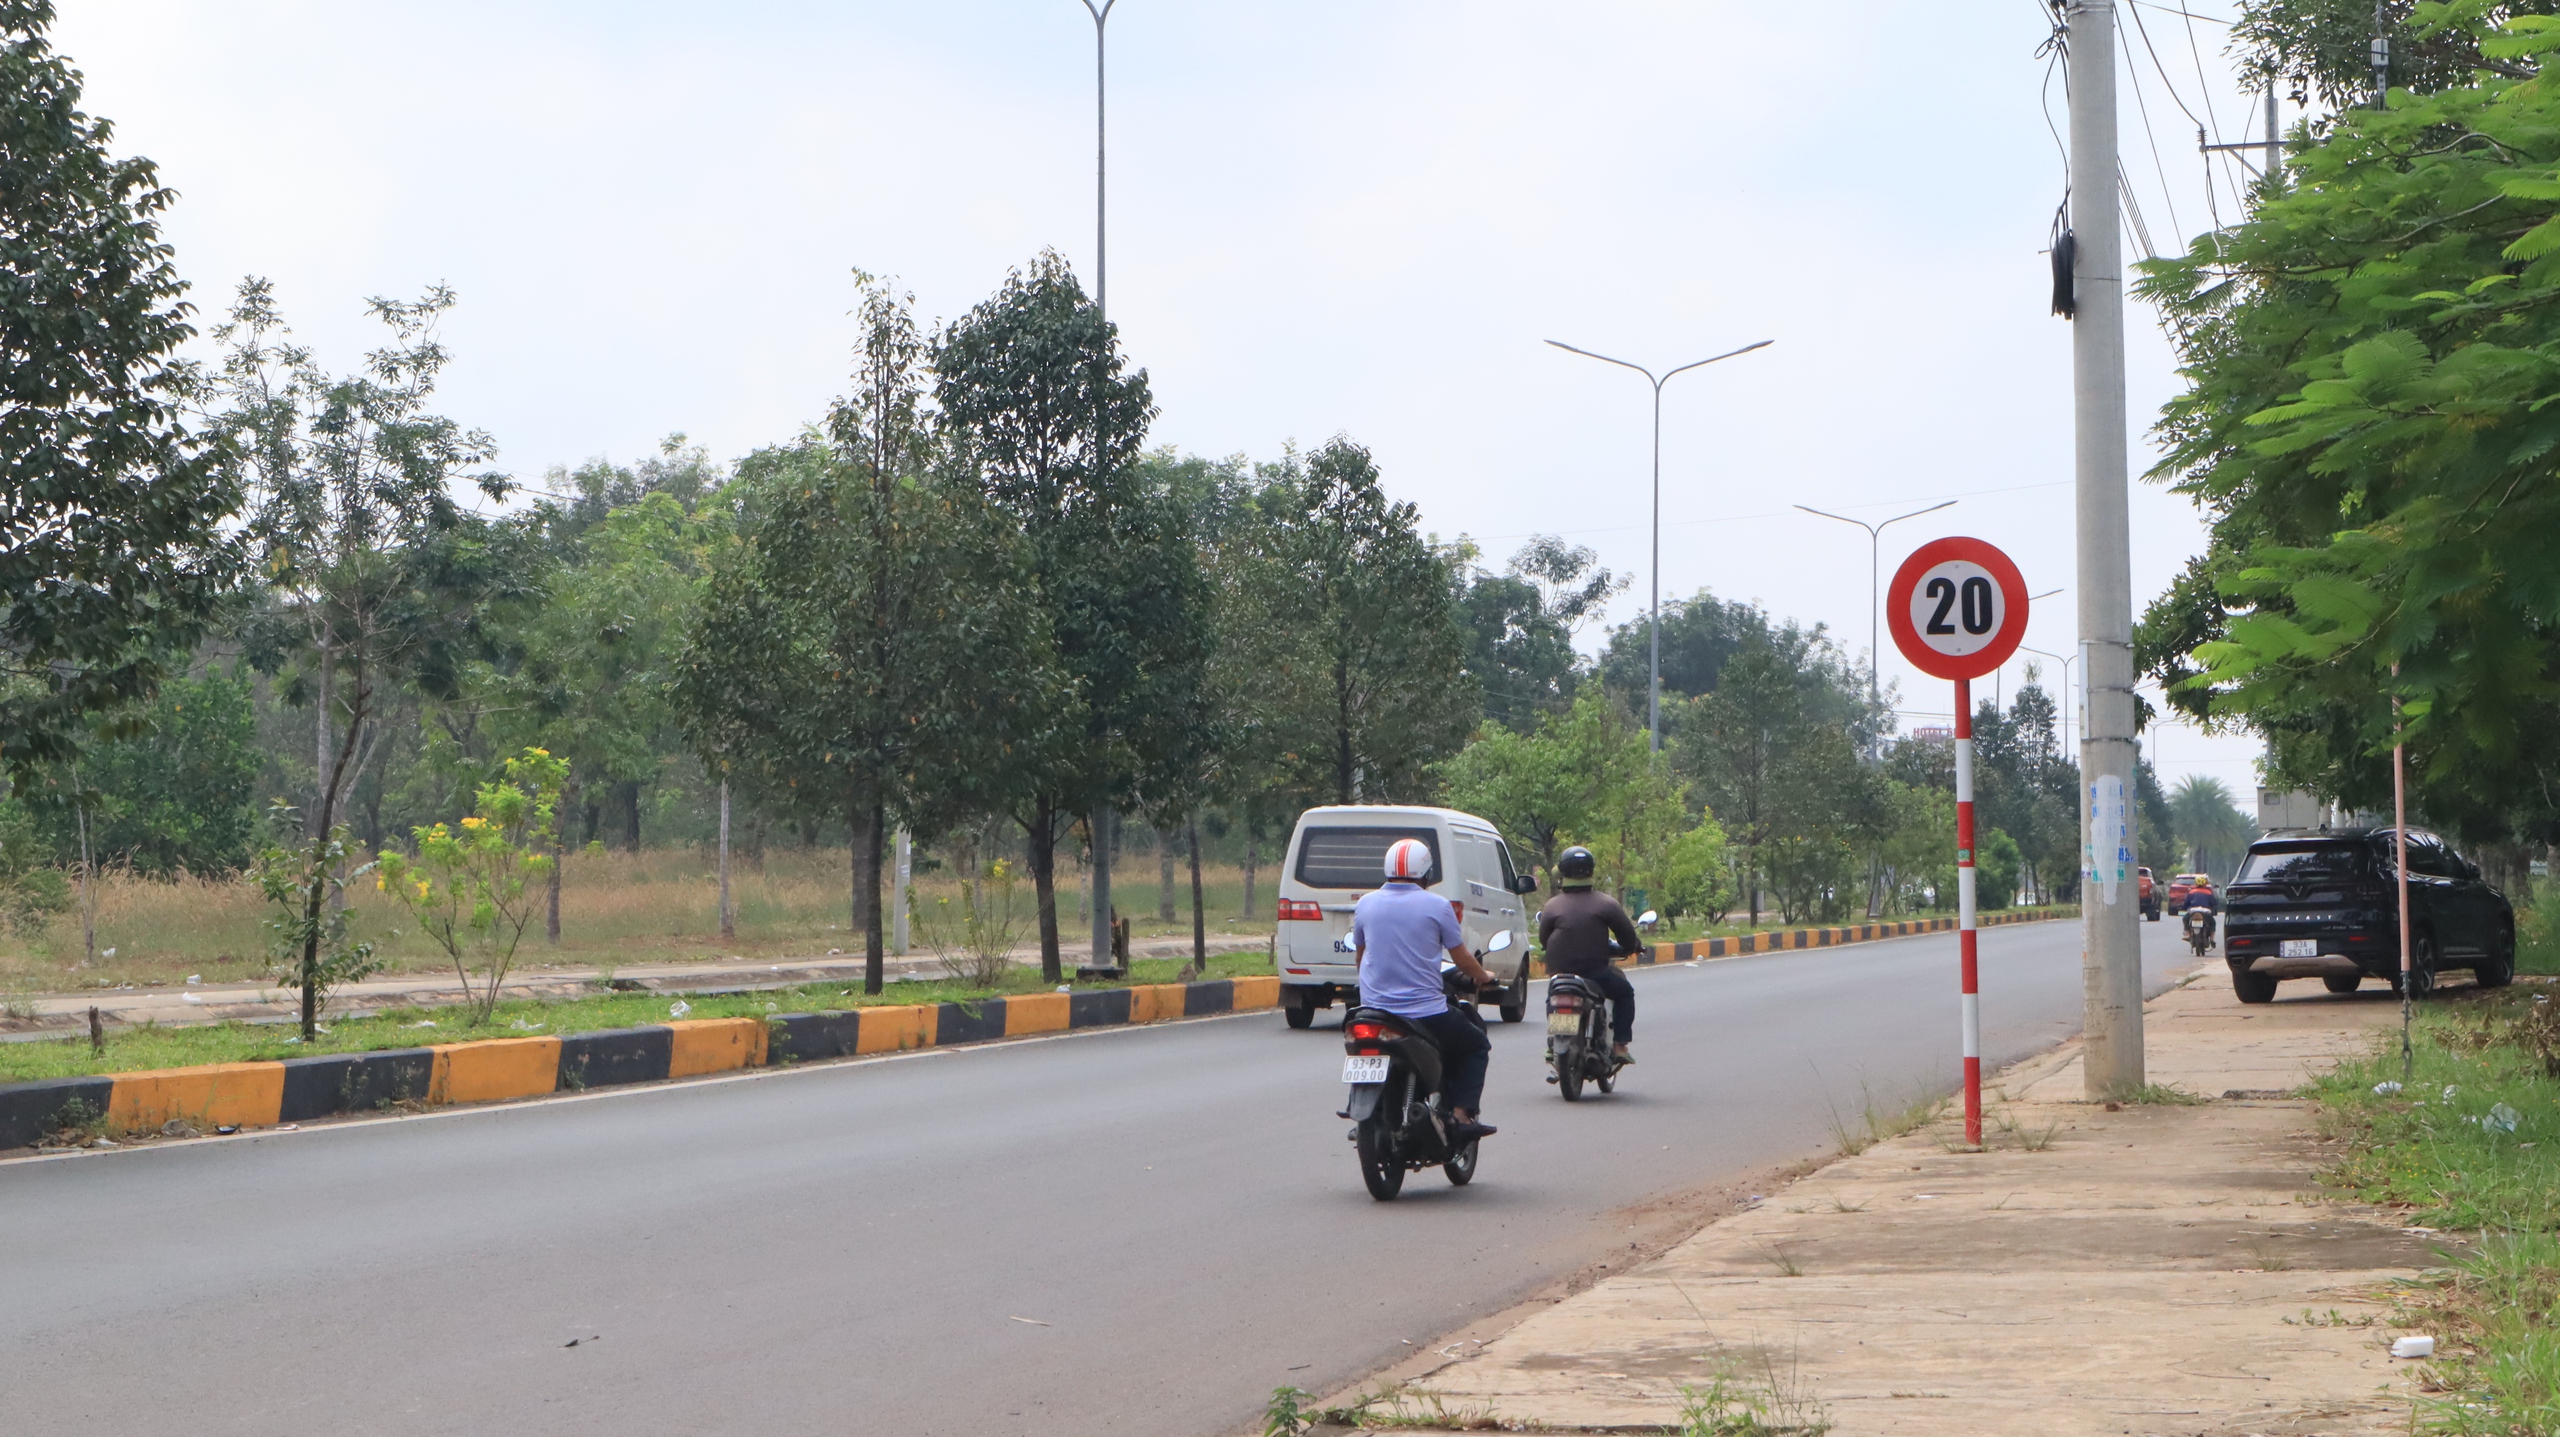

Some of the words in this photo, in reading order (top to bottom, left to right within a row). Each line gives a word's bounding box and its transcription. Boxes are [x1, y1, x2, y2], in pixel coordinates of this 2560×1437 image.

[1926, 576, 1993, 636] 20
[2266, 914, 2332, 922] VINFAST
[2293, 940, 2308, 949] 93A
[1352, 1058, 1382, 1070] 93-P3
[1346, 1069, 1384, 1082] 009.00
